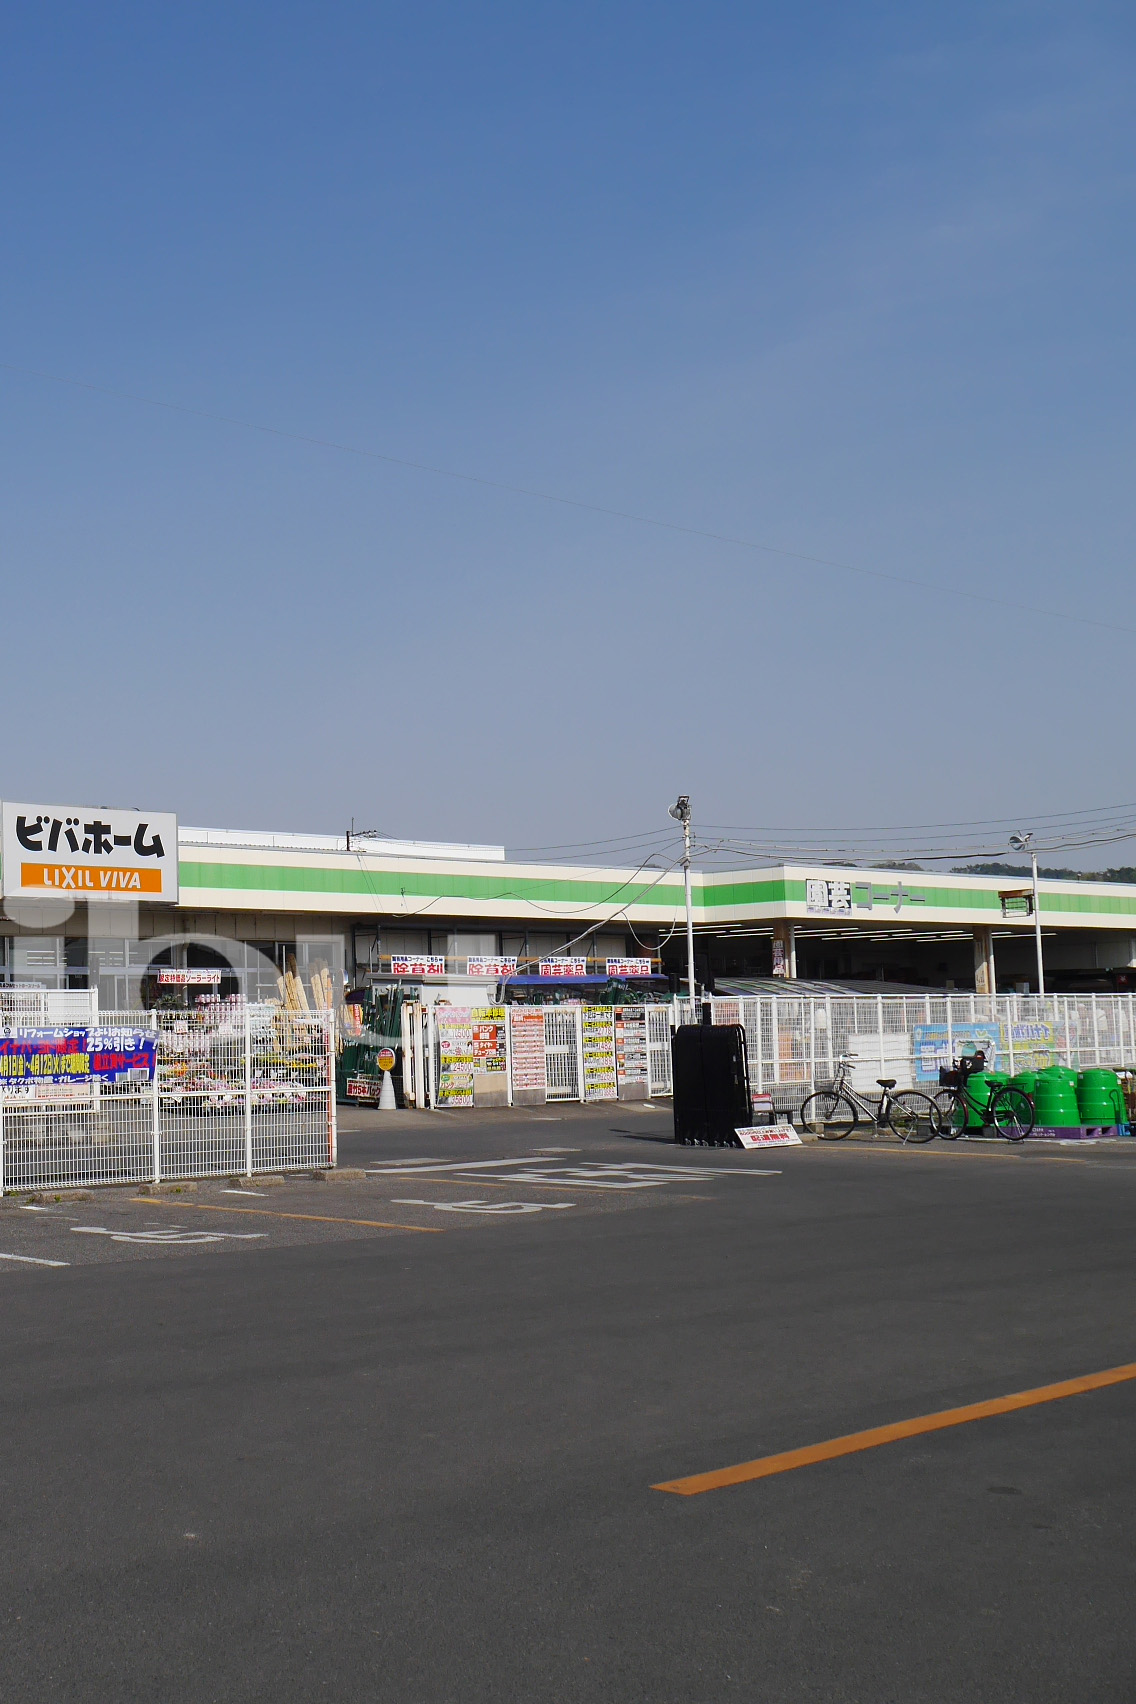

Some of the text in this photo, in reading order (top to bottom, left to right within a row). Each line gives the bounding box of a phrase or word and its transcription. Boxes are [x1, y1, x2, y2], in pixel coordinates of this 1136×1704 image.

[16, 816, 165, 858] ビバホーム
[44, 867, 141, 888] LIXIL VIVA
[806, 879, 925, 913] 園芸コーナー
[393, 963, 444, 975] 除草剤
